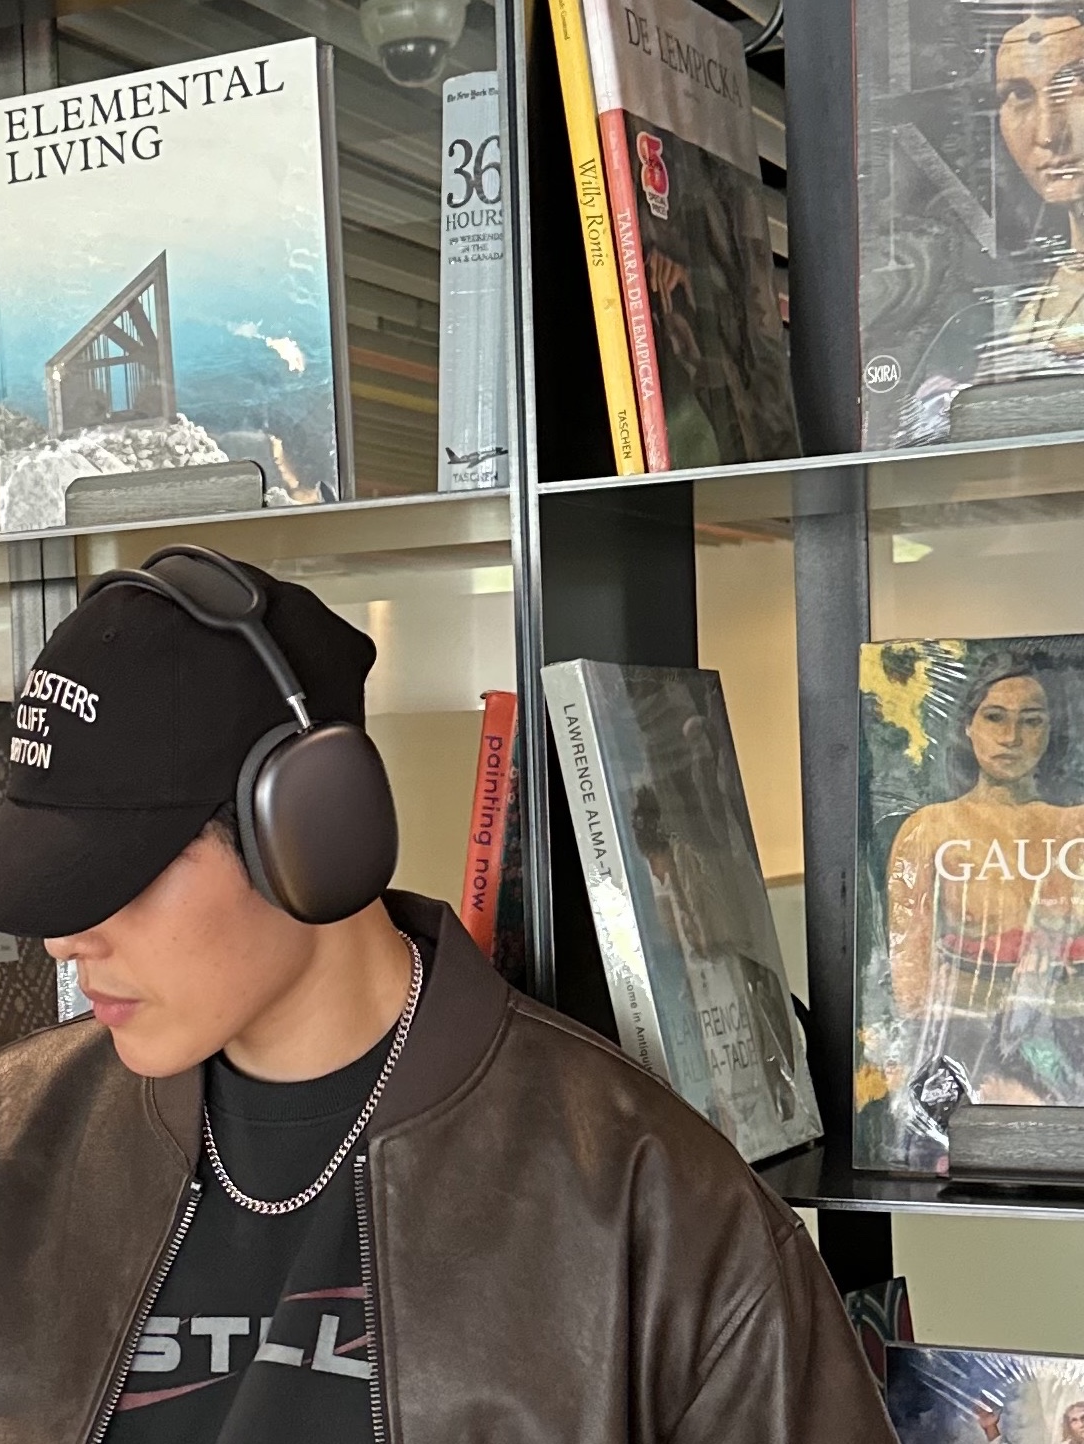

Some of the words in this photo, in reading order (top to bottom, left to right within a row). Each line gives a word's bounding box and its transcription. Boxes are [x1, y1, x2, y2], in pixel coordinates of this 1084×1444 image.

[625, 8, 651, 55] DE
[656, 26, 743, 108] LEMPICKA
[4, 59, 285, 143] ELEMENTAL
[6, 125, 164, 185] LIVING
[447, 135, 503, 208] 36
[578, 158, 602, 208] Willy
[446, 209, 503, 231] HOURS
[586, 213, 608, 267] Ronis
[617, 208, 639, 285] TAMARA
[627, 288, 643, 311] DE
[632, 316, 655, 401] LEMPICKA
[867, 363, 898, 384] SKIRA
[617, 409, 632, 460] TASCHEN
[563, 703, 596, 804] LAWRENCE
[473, 735, 505, 846] painting
[472, 858, 490, 912] now
